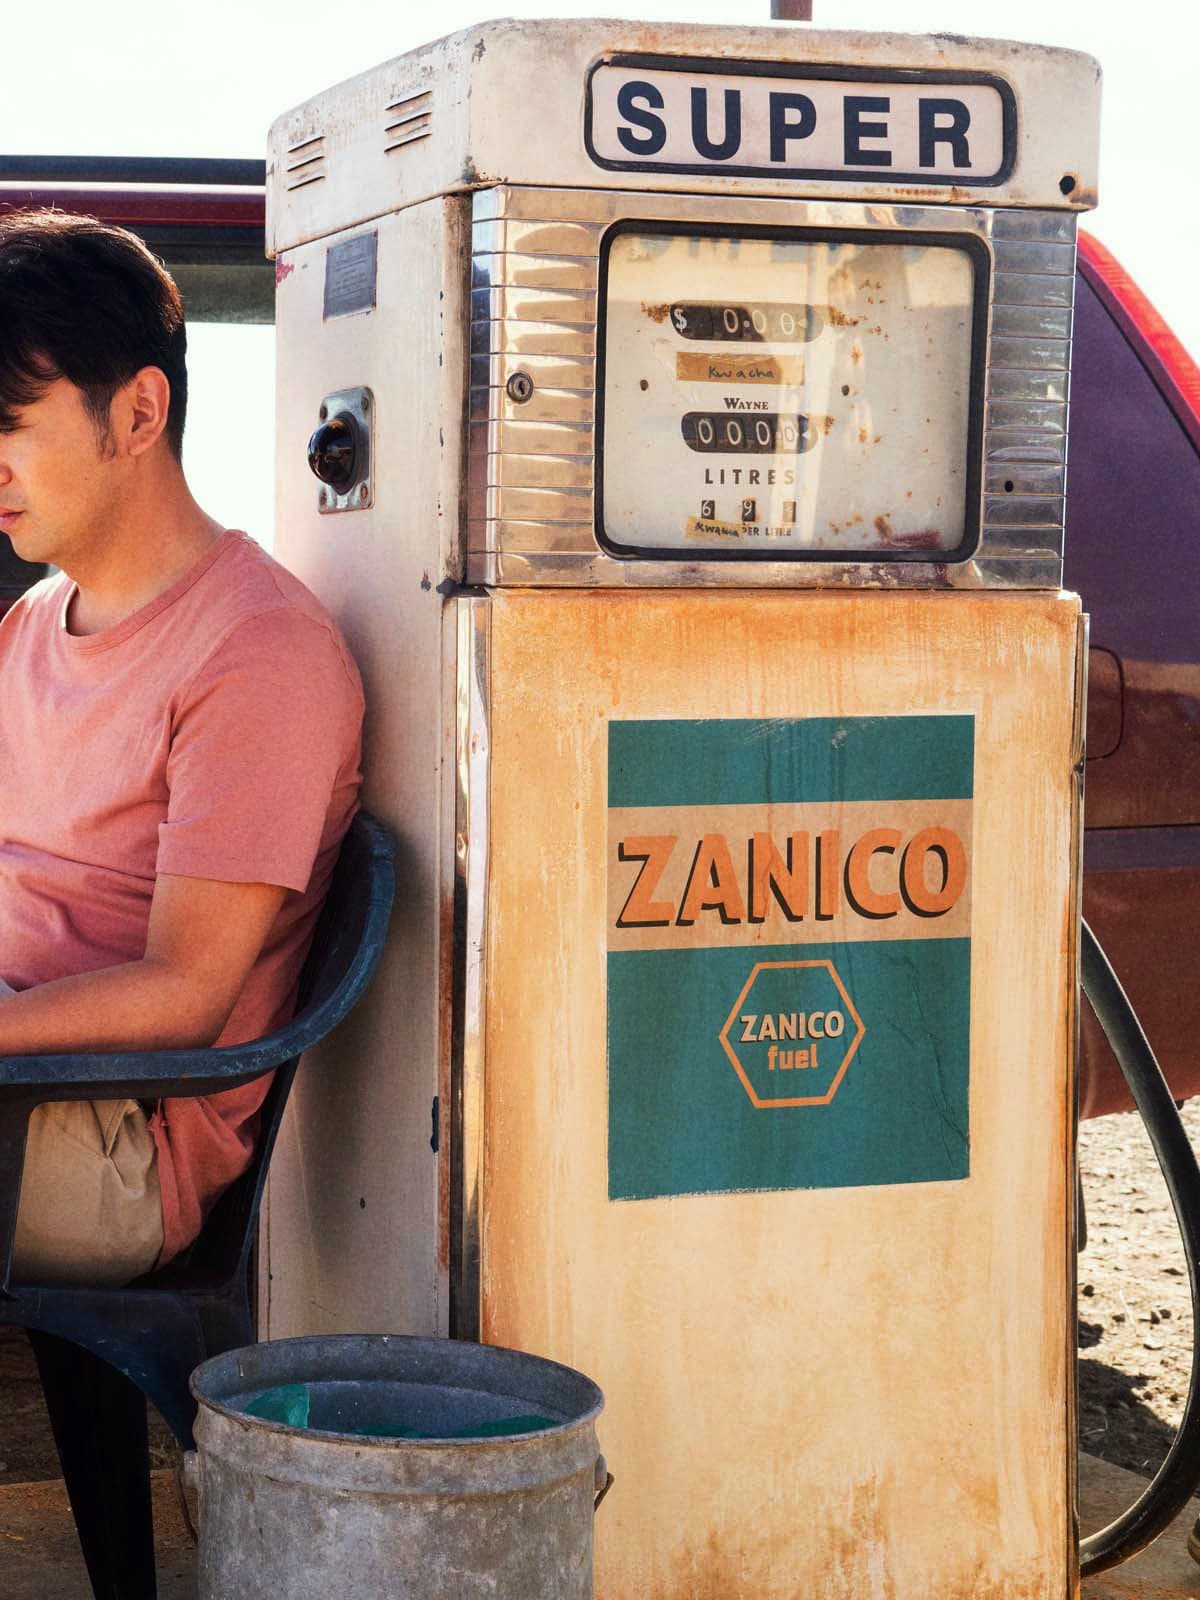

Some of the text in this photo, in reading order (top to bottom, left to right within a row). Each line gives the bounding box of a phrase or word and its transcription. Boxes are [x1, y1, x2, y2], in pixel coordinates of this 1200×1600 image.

[616, 81, 972, 168] SUPER
[673, 308, 688, 332] $
[704, 468, 795, 485] LITRES
[741, 527, 760, 537] PER
[617, 828, 967, 928] ZANICO
[739, 1010, 845, 1043] ZANICO
[767, 1043, 819, 1071] fuel
